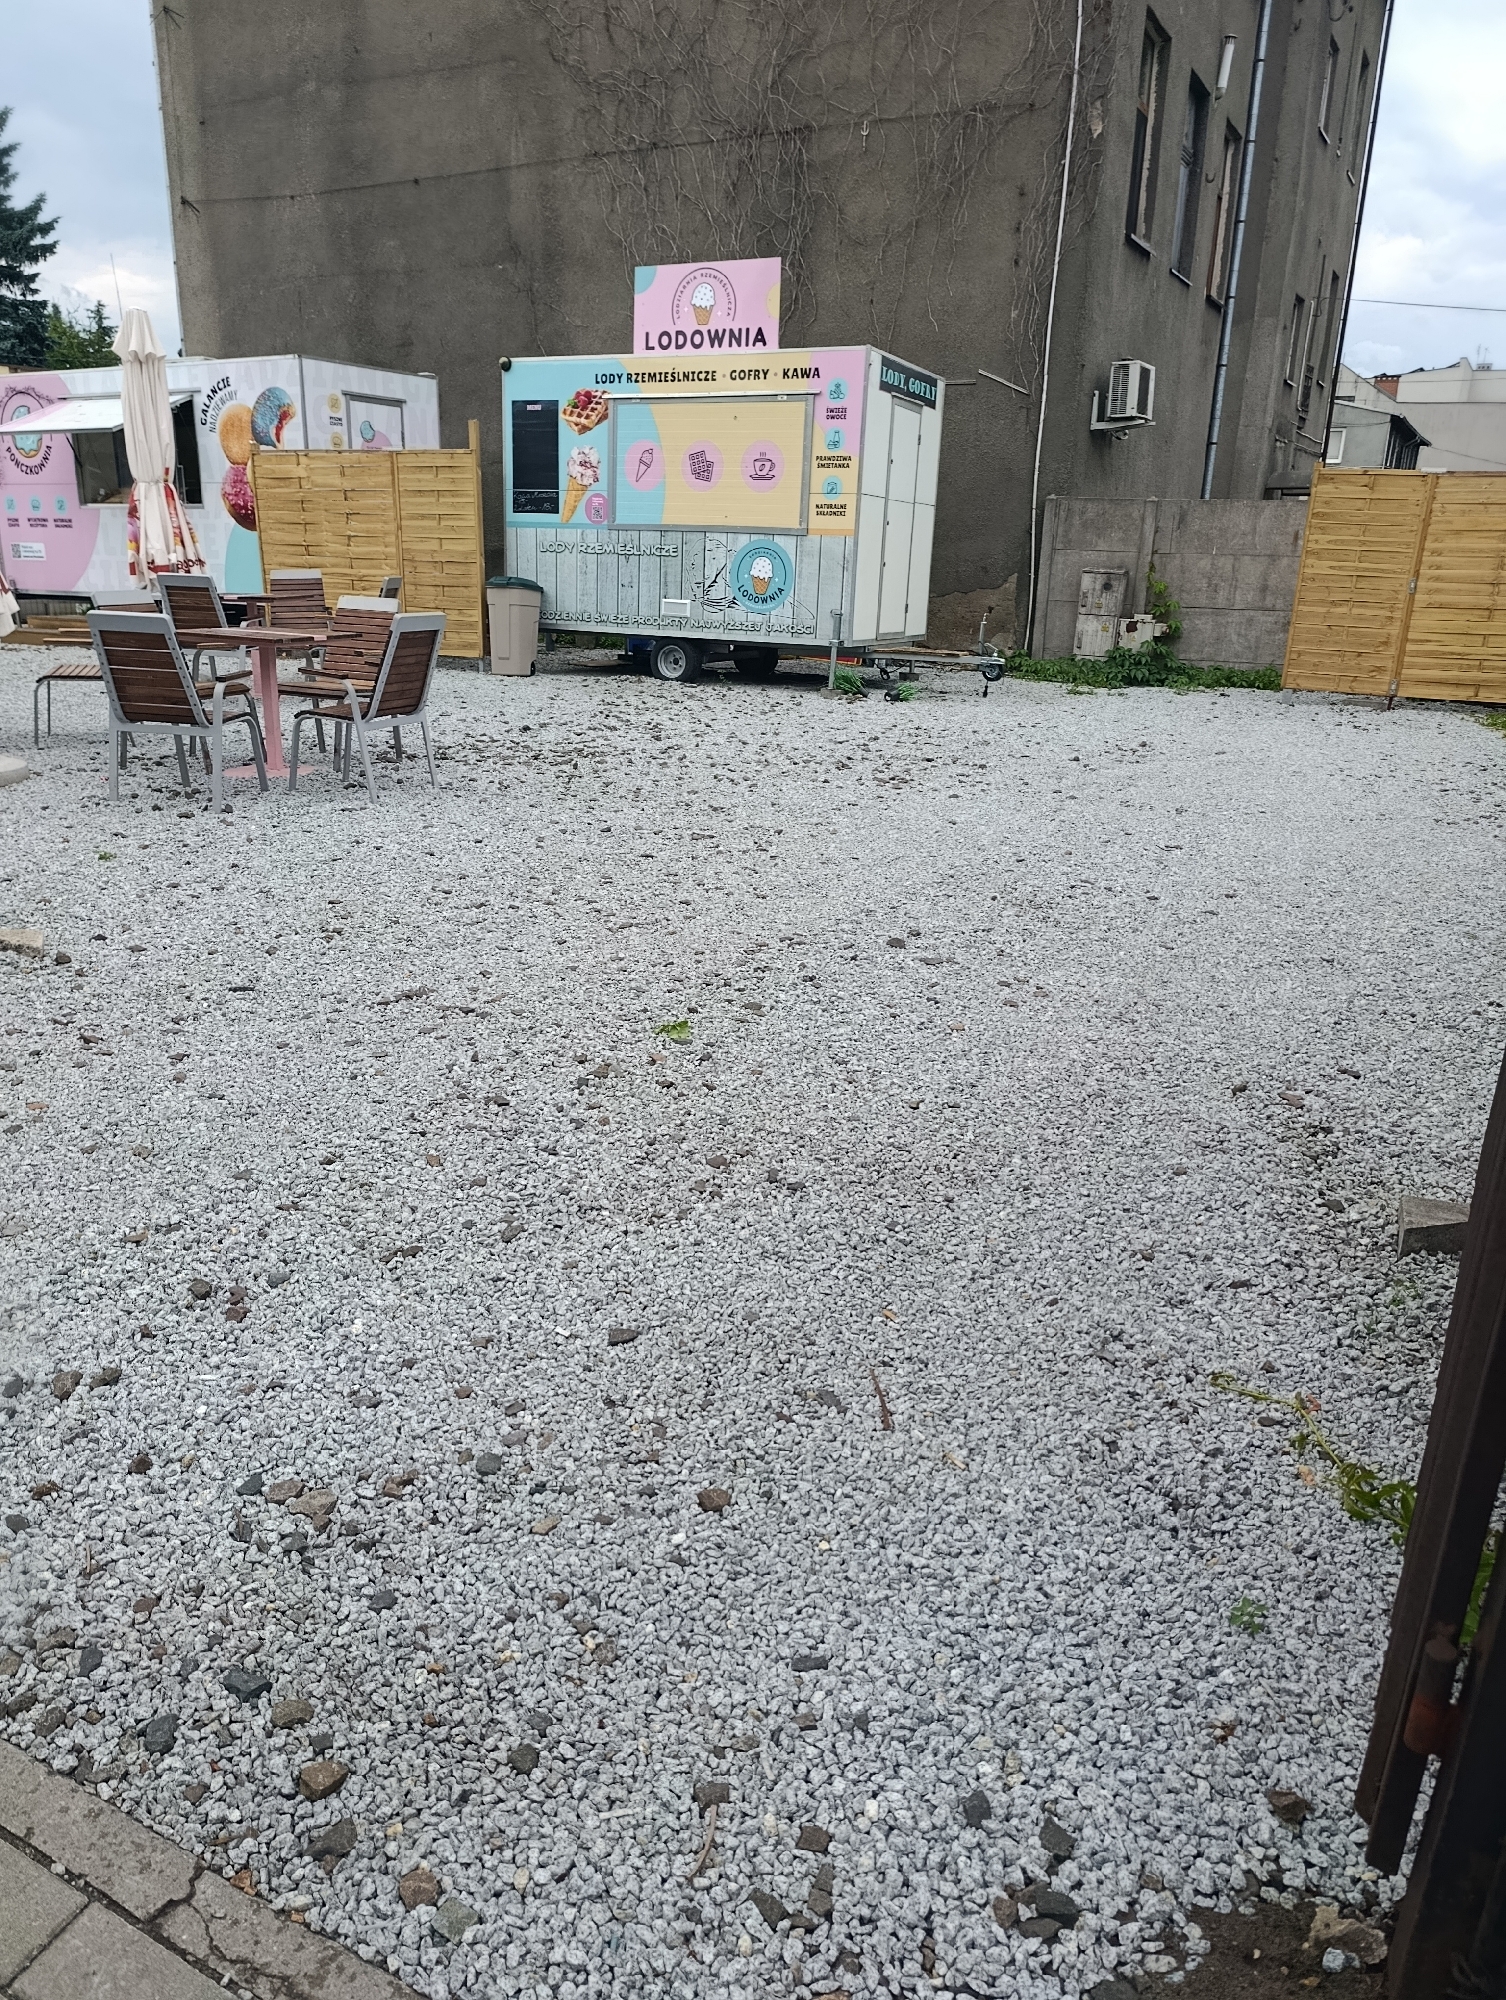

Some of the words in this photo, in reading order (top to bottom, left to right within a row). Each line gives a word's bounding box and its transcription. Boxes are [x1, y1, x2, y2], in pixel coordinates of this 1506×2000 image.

[675, 275, 698, 320] LODZIARNIA
[645, 327, 767, 351] LODOWNIA
[594, 373, 624, 385] LODY
[626, 367, 717, 384] RZEMIEŚLNICZE
[729, 368, 770, 381] GOFRY
[782, 367, 821, 380] KAWA
[881, 366, 907, 392] LODY,
[908, 377, 938, 401] GOFRY
[200, 376, 231, 426] GALANCIE
[826, 405, 848, 413] ŚWIEŻE
[6, 445, 52, 475] PONCZKOWNIA
[816, 461, 850, 469] ŚMIETANKA
[540, 541, 576, 553] LODY
[737, 584, 785, 604] LODOWNIA
[631, 614, 688, 627] PRODUKTY
[765, 623, 815, 635] JAKOŚCI
